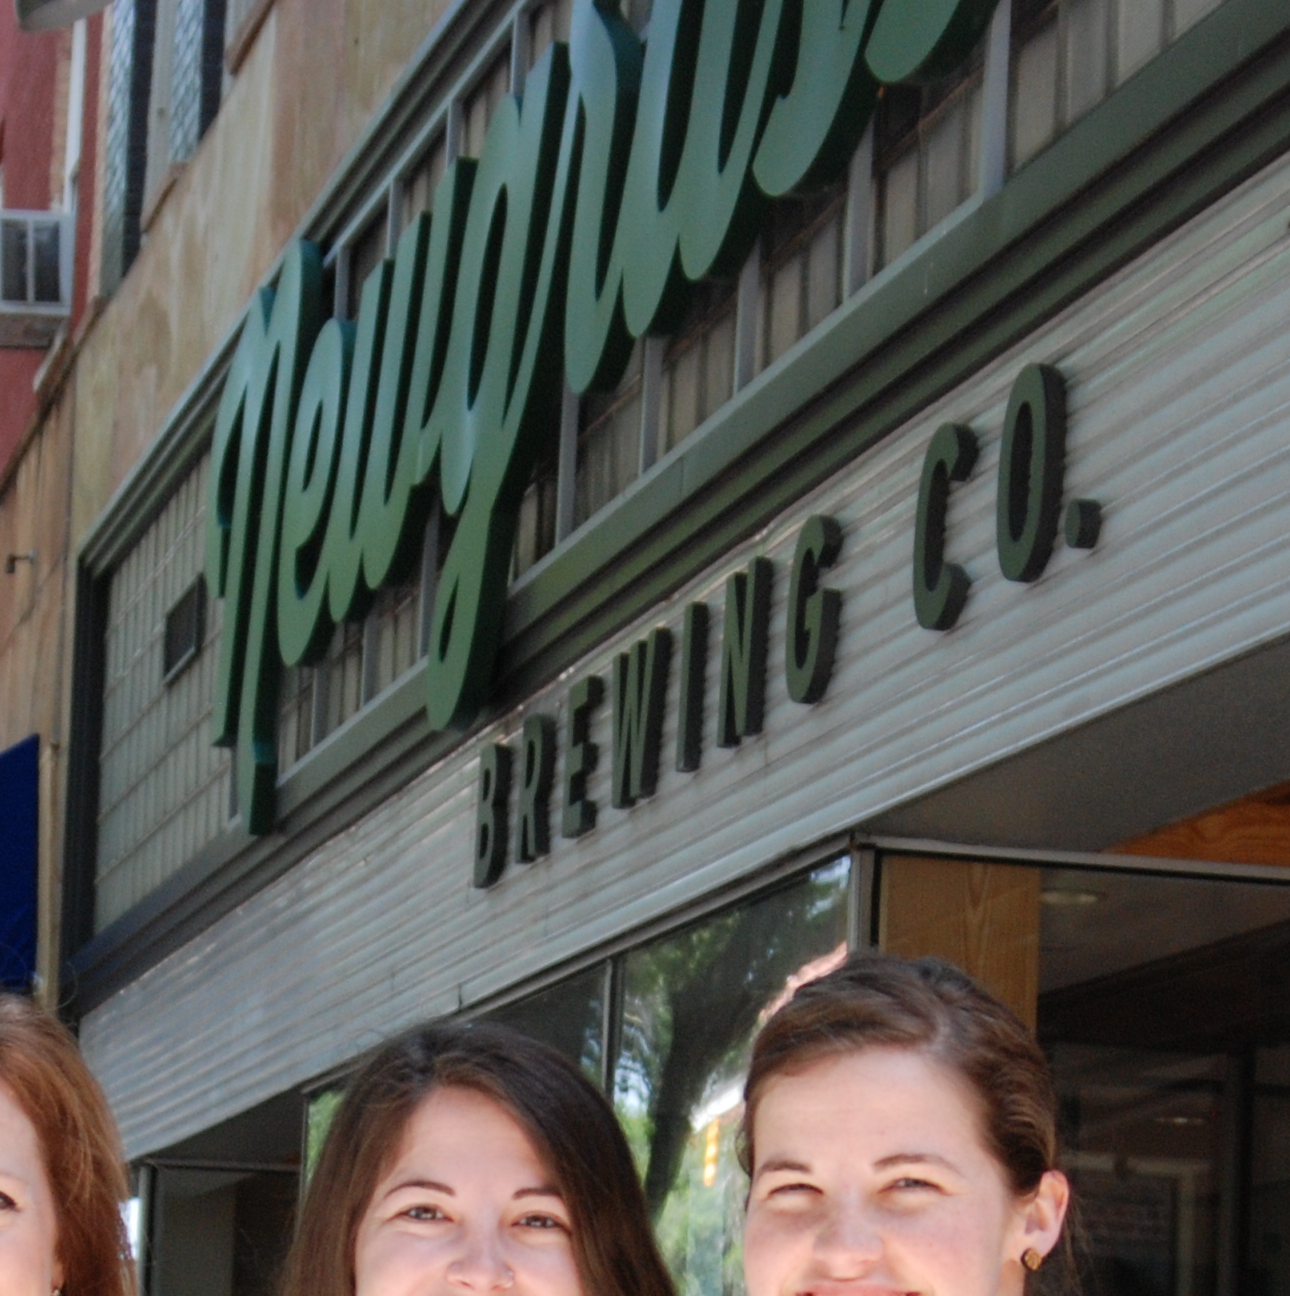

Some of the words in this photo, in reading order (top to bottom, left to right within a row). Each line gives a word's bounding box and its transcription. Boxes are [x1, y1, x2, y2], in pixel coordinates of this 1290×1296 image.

[203, 0, 984, 834] Newgra
[474, 514, 841, 888] BREWING
[912, 361, 1102, 631] CO.
